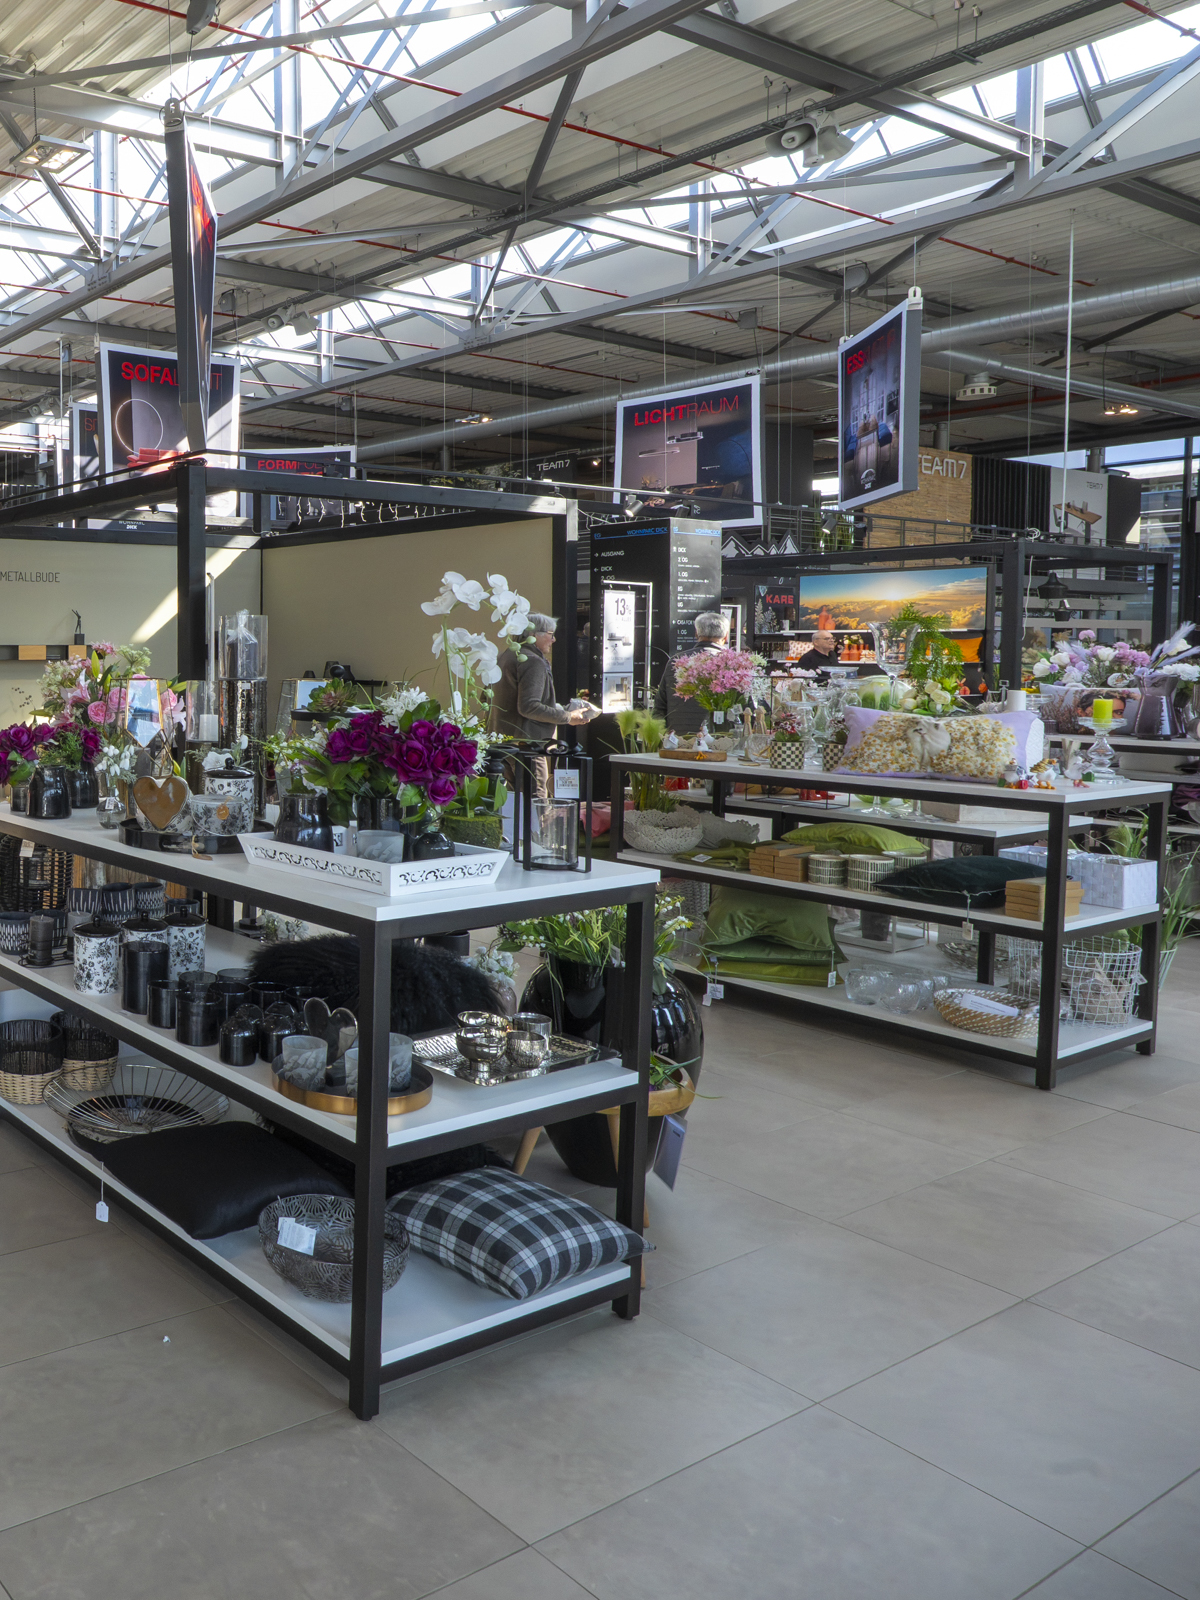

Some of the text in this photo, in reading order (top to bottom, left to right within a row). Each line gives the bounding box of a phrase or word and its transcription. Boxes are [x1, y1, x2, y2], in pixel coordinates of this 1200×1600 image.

[634, 395, 739, 427] LICHTRAUM
[600, 550, 625, 558] AUSGANG
[0, 570, 61, 583] METALLBUDE
[765, 593, 794, 605] KARE
